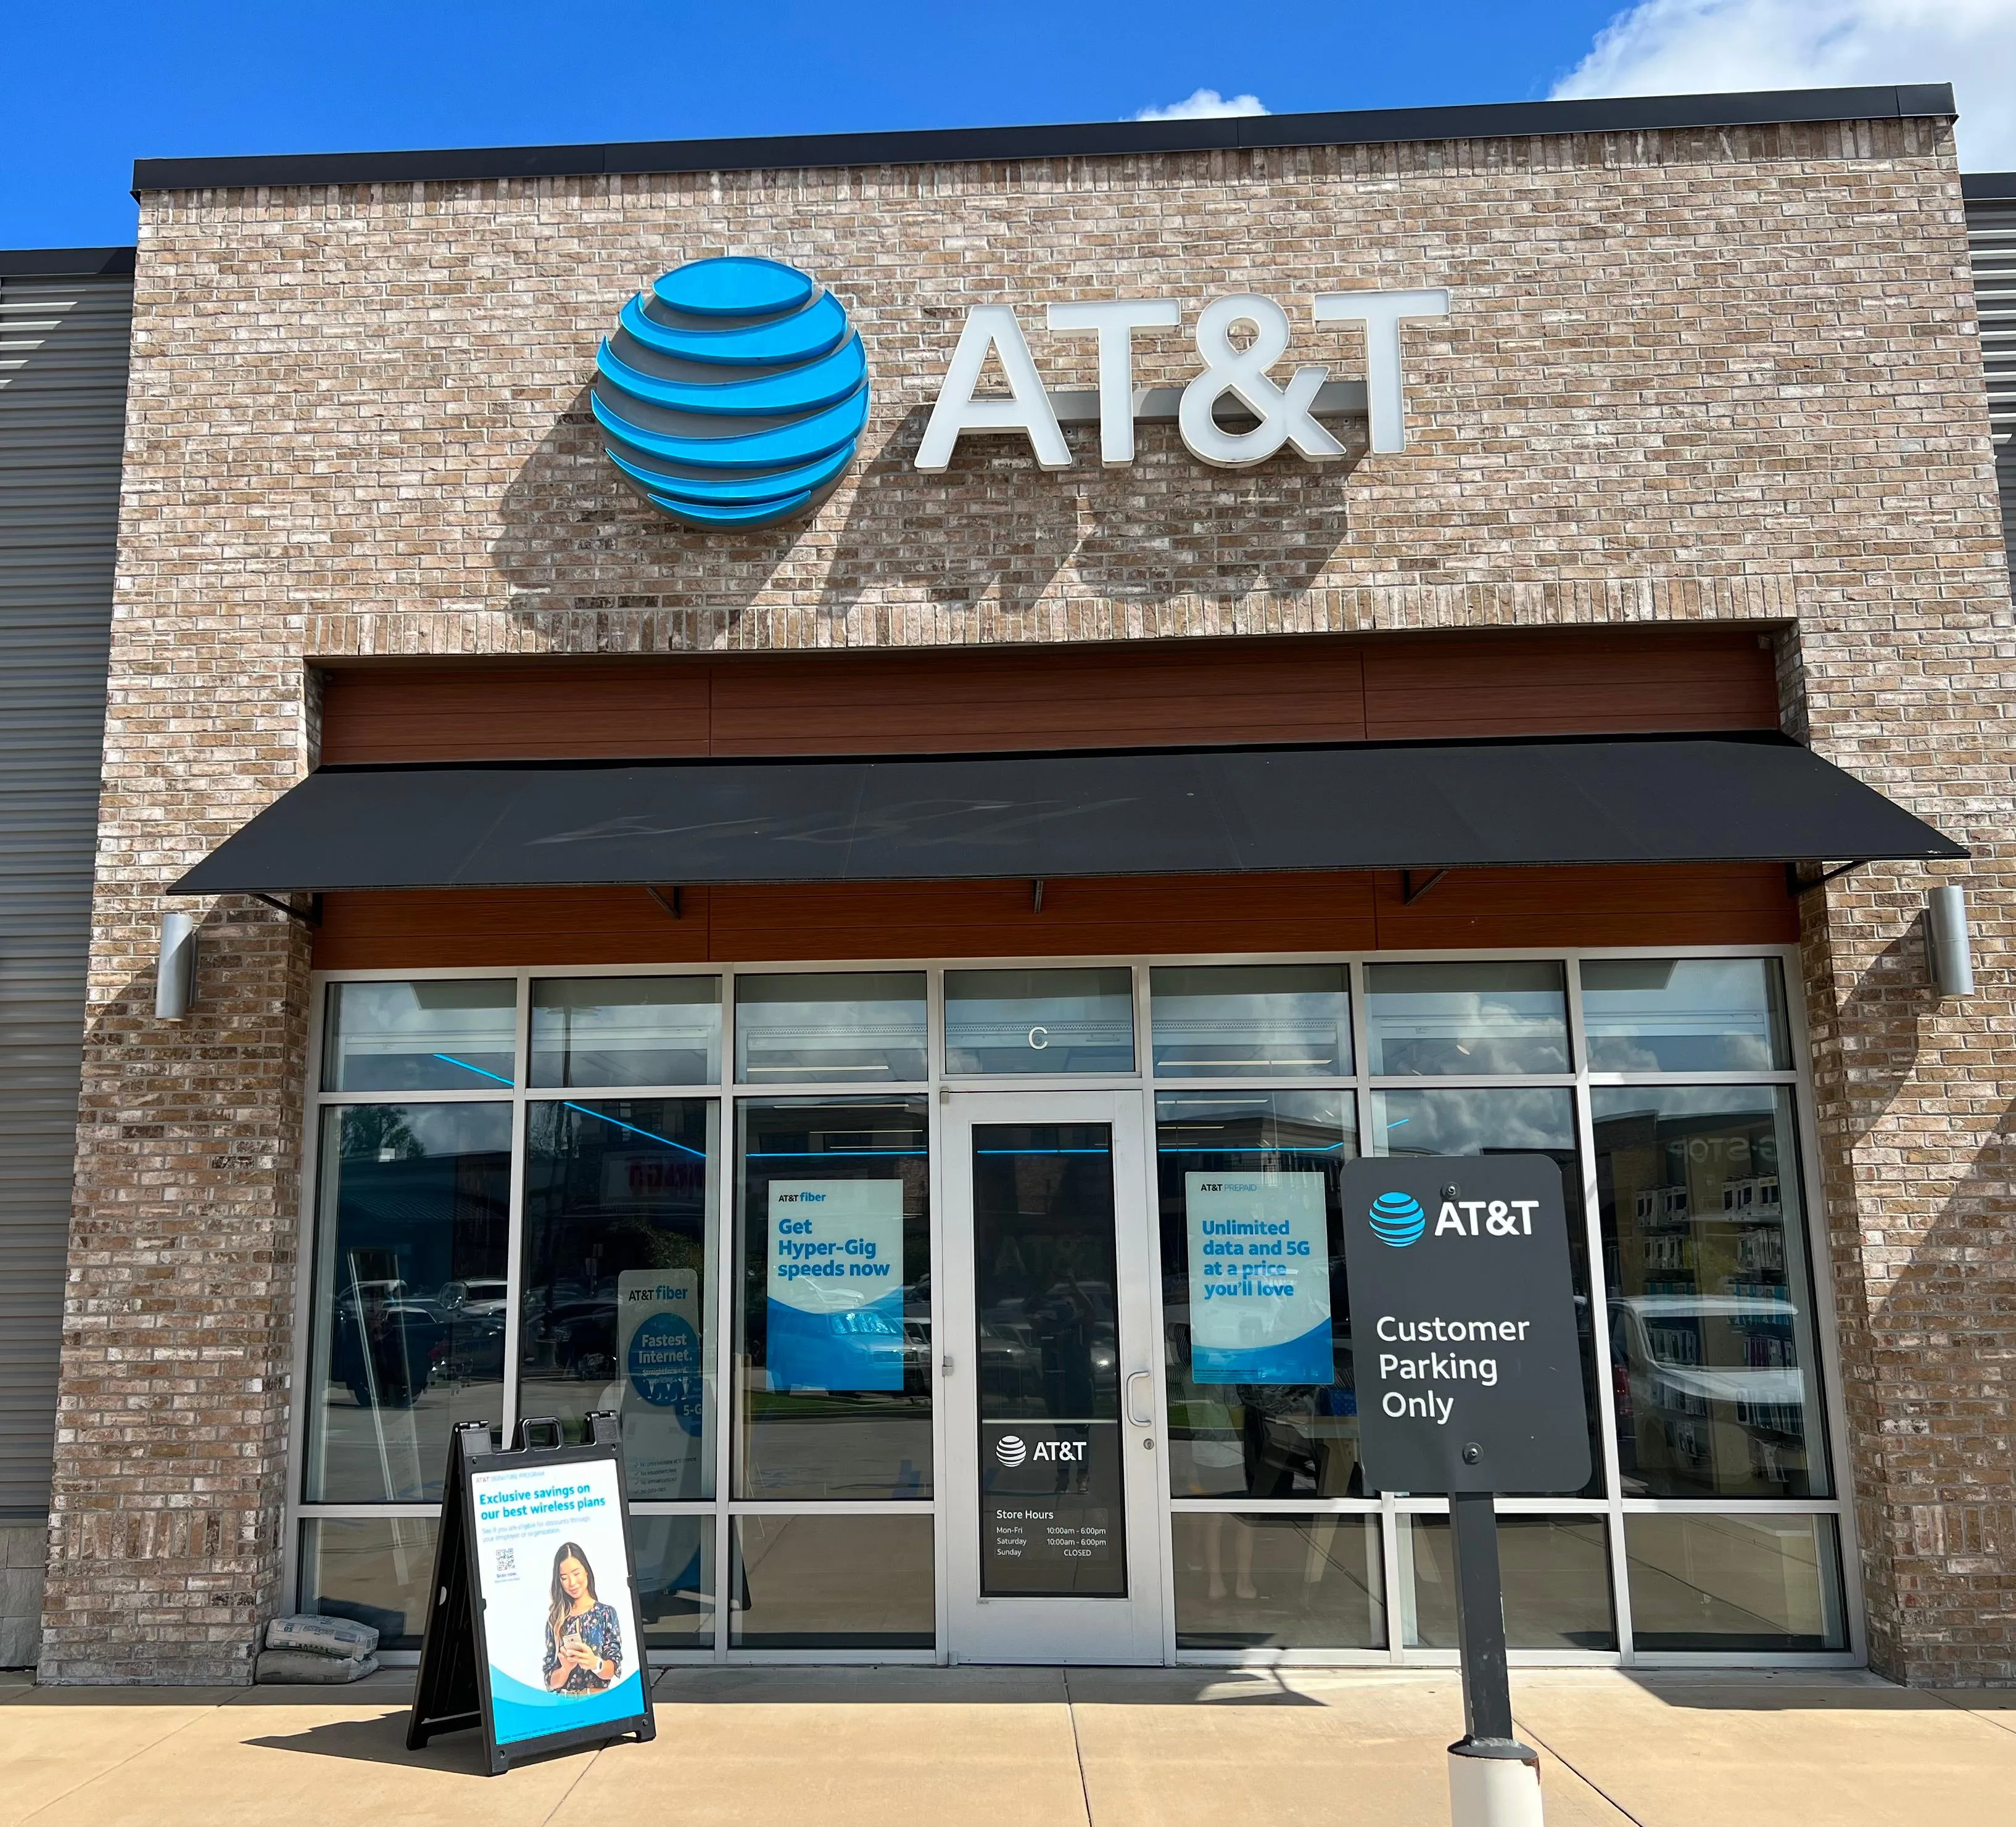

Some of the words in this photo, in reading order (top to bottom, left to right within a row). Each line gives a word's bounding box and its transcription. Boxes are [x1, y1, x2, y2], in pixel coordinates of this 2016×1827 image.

[914, 289, 1450, 472] AT&T
[1028, 1026, 1048, 1050] C
[1200, 1184, 1223, 1192] AT&T
[1224, 1184, 1257, 1192] PREPAID
[779, 1194, 798, 1202] AT&T
[799, 1192, 826, 1202] fiber
[779, 1219, 812, 1234] Get
[1434, 1200, 1540, 1236] AT&T
[1202, 1219, 1289, 1235] Unlimited
[779, 1239, 876, 1260] Hyper-Gig
[1203, 1240, 1244, 1255] data
[1249, 1240, 1282, 1255] and
[1286, 1240, 1310, 1255] 5G
[778, 1260, 845, 1281] speeds
[850, 1263, 890, 1276] now
[1204, 1263, 1222, 1276] at
[1228, 1264, 1237, 1276] a
[1243, 1261, 1287, 1279] price
[629, 1289, 655, 1301] AT&T
[656, 1285, 688, 1300] fiber
[1204, 1281, 1252, 1300] you'll
[1258, 1281, 1294, 1297] love
[1376, 1316, 1530, 1342] Customer
[642, 1334, 687, 1348] Fastest
[639, 1350, 692, 1364] Internet.
[1379, 1352, 1498, 1387] Parking
[1382, 1390, 1455, 1425] Only
[1033, 1441, 1087, 1461] AT&T
[519, 1471, 545, 1480] PROGRAM
[479, 1490, 531, 1506] Exclusive
[534, 1485, 574, 1499] savings
[578, 1484, 590, 1494] on
[481, 1509, 500, 1520] our
[503, 1506, 527, 1518] best
[531, 1500, 575, 1515] wireless
[577, 1496, 606, 1511] plans
[996, 1509, 1023, 1519] Store
[1025, 1510, 1054, 1519] Hours
[1080, 1527, 1106, 1536] 6:00pm
[997, 1538, 1027, 1546] Saturday
[1081, 1539, 1106, 1547] 6:00pm
[997, 1548, 1022, 1557] Sunday
